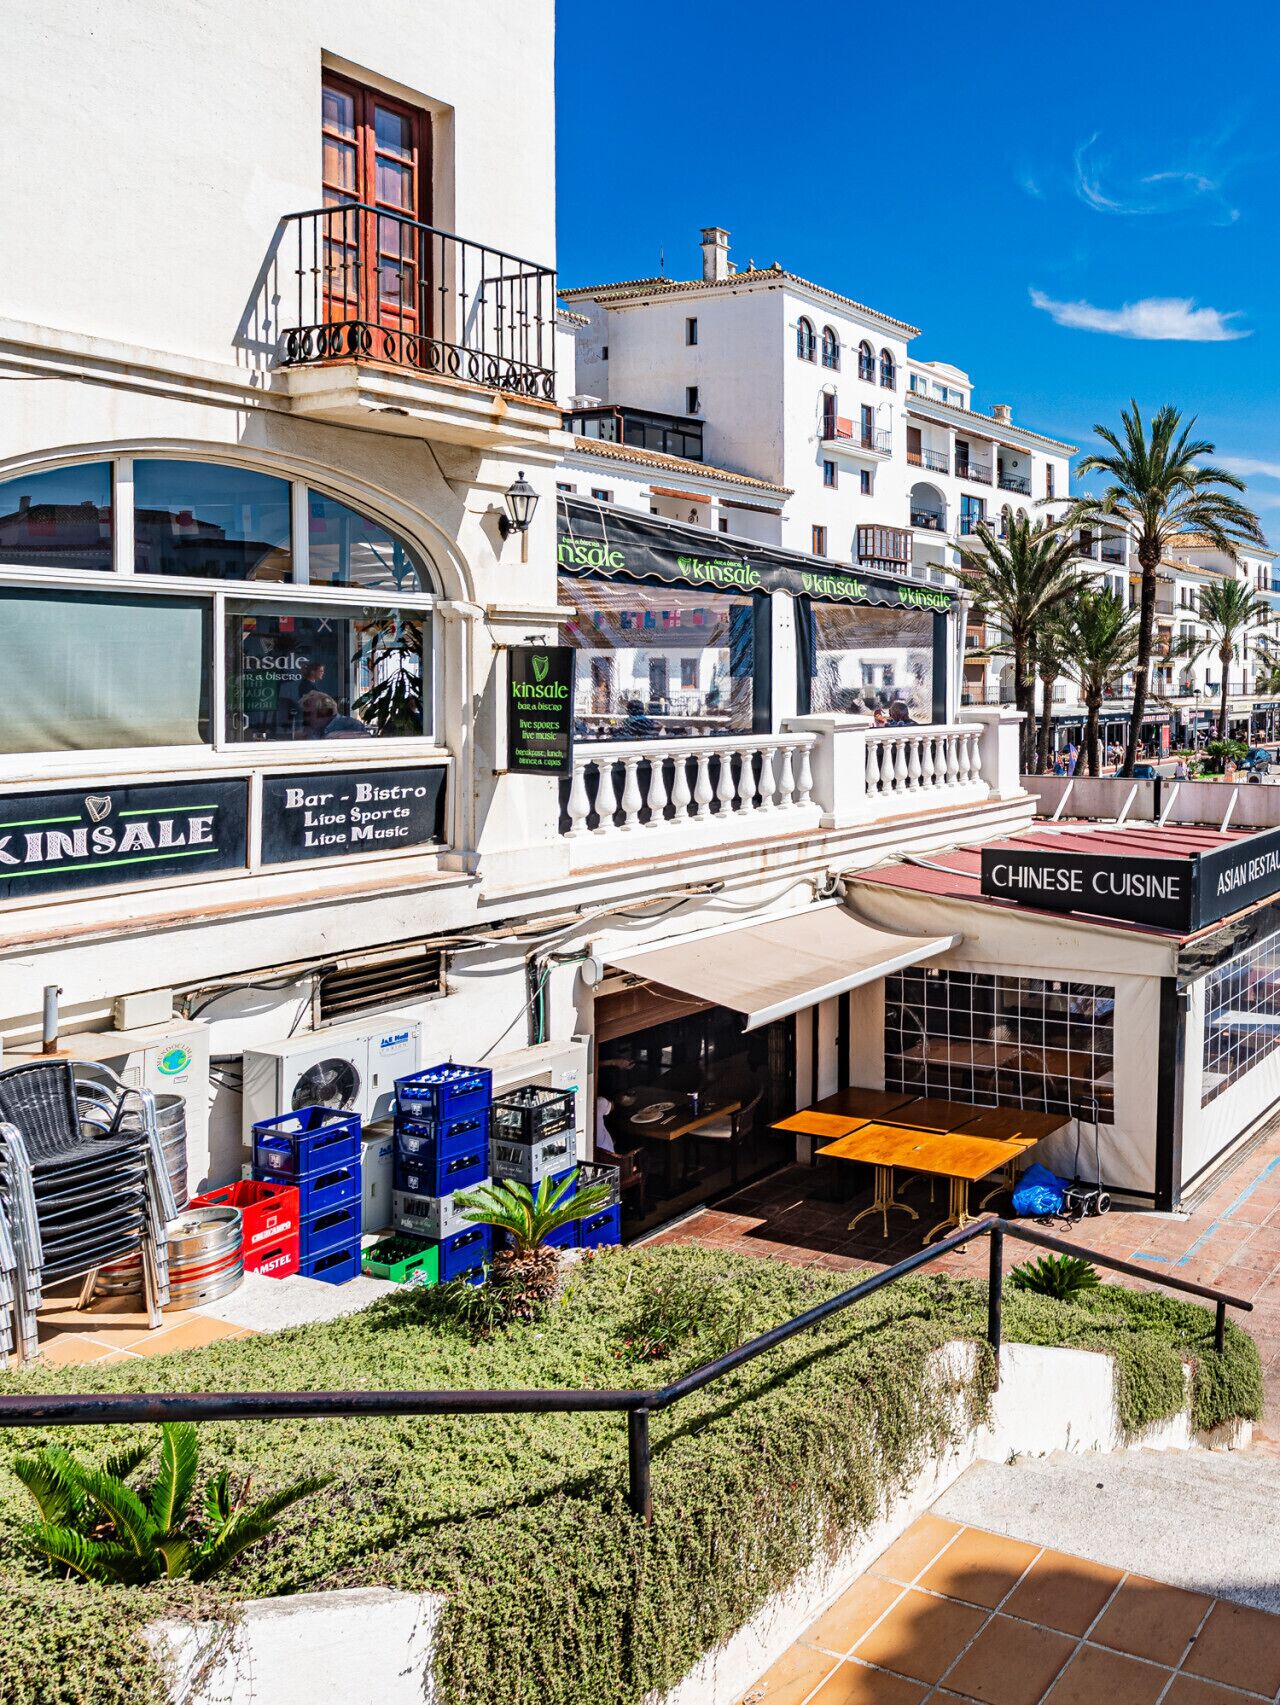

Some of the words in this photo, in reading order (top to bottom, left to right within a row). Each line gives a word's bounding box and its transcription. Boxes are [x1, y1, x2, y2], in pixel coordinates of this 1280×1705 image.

[692, 559, 761, 586] kinsale
[813, 574, 867, 598] kinsale
[907, 587, 952, 608] kinsale
[512, 681, 568, 699] kinsale
[285, 788, 334, 809] Bar
[355, 783, 427, 803] Bistro
[304, 810, 347, 828] Live
[350, 806, 411, 824] Sports
[0, 815, 214, 865] KINSALE
[304, 830, 347, 848] Live
[350, 824, 409, 842] Music
[991, 864, 1084, 894] CHINESE
[1092, 870, 1180, 900] CUISINE
[1216, 863, 1248, 897] ASIAN
[252, 1253, 292, 1275] AMSTEL
